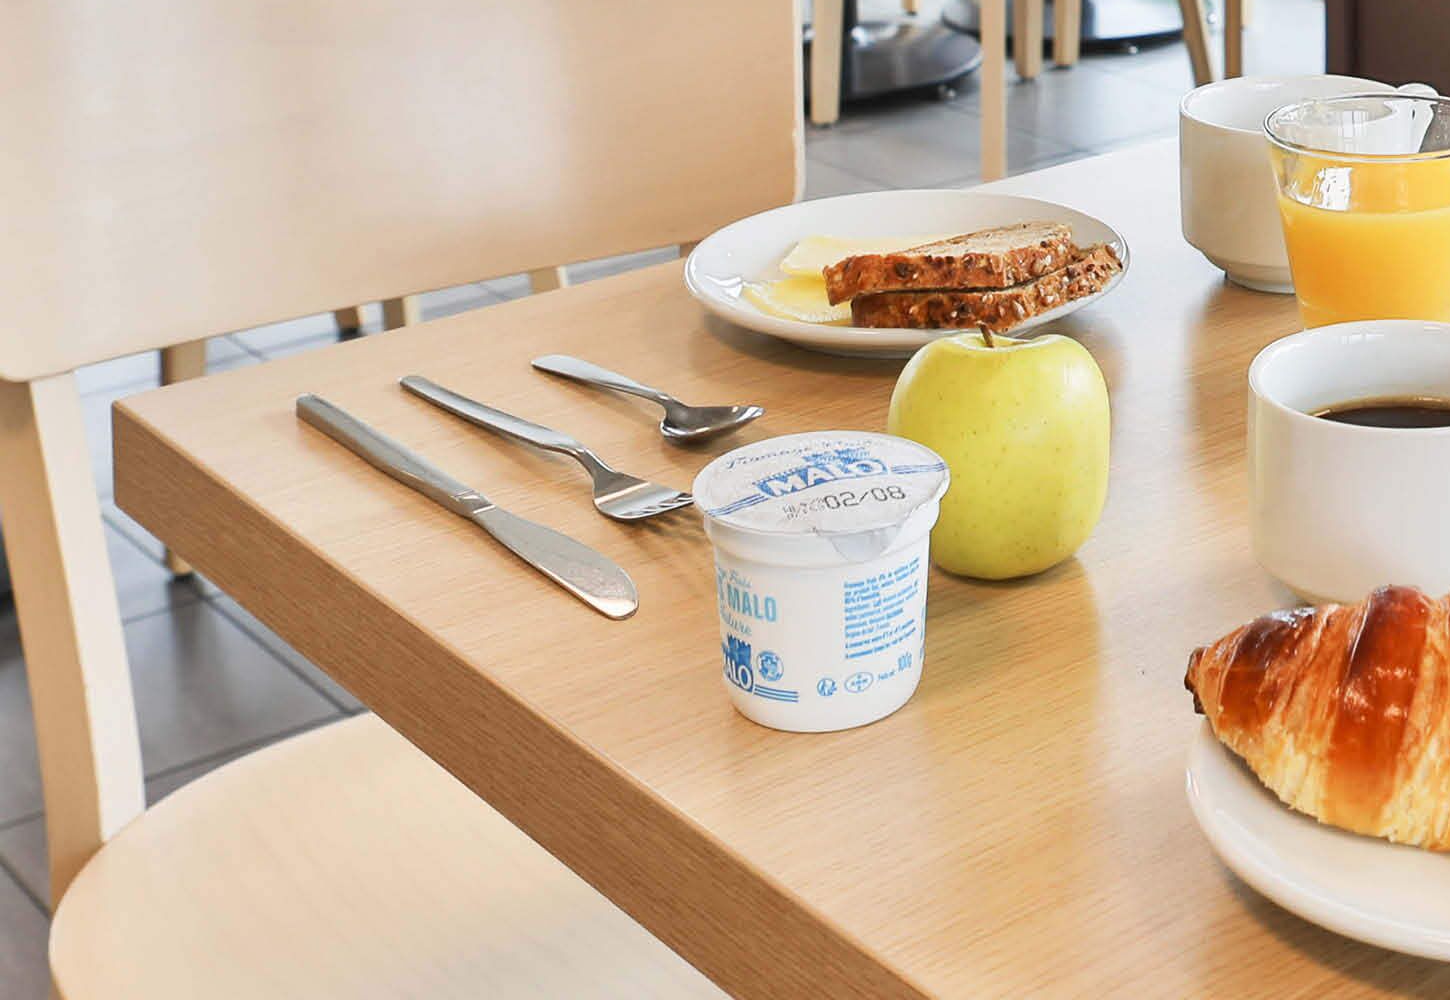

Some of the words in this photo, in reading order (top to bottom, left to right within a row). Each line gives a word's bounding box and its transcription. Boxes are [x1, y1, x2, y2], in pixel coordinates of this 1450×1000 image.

[765, 458, 888, 498] MALO
[823, 484, 907, 511] 02/08
[726, 583, 778, 623] MALO
[722, 653, 753, 691] ALO
